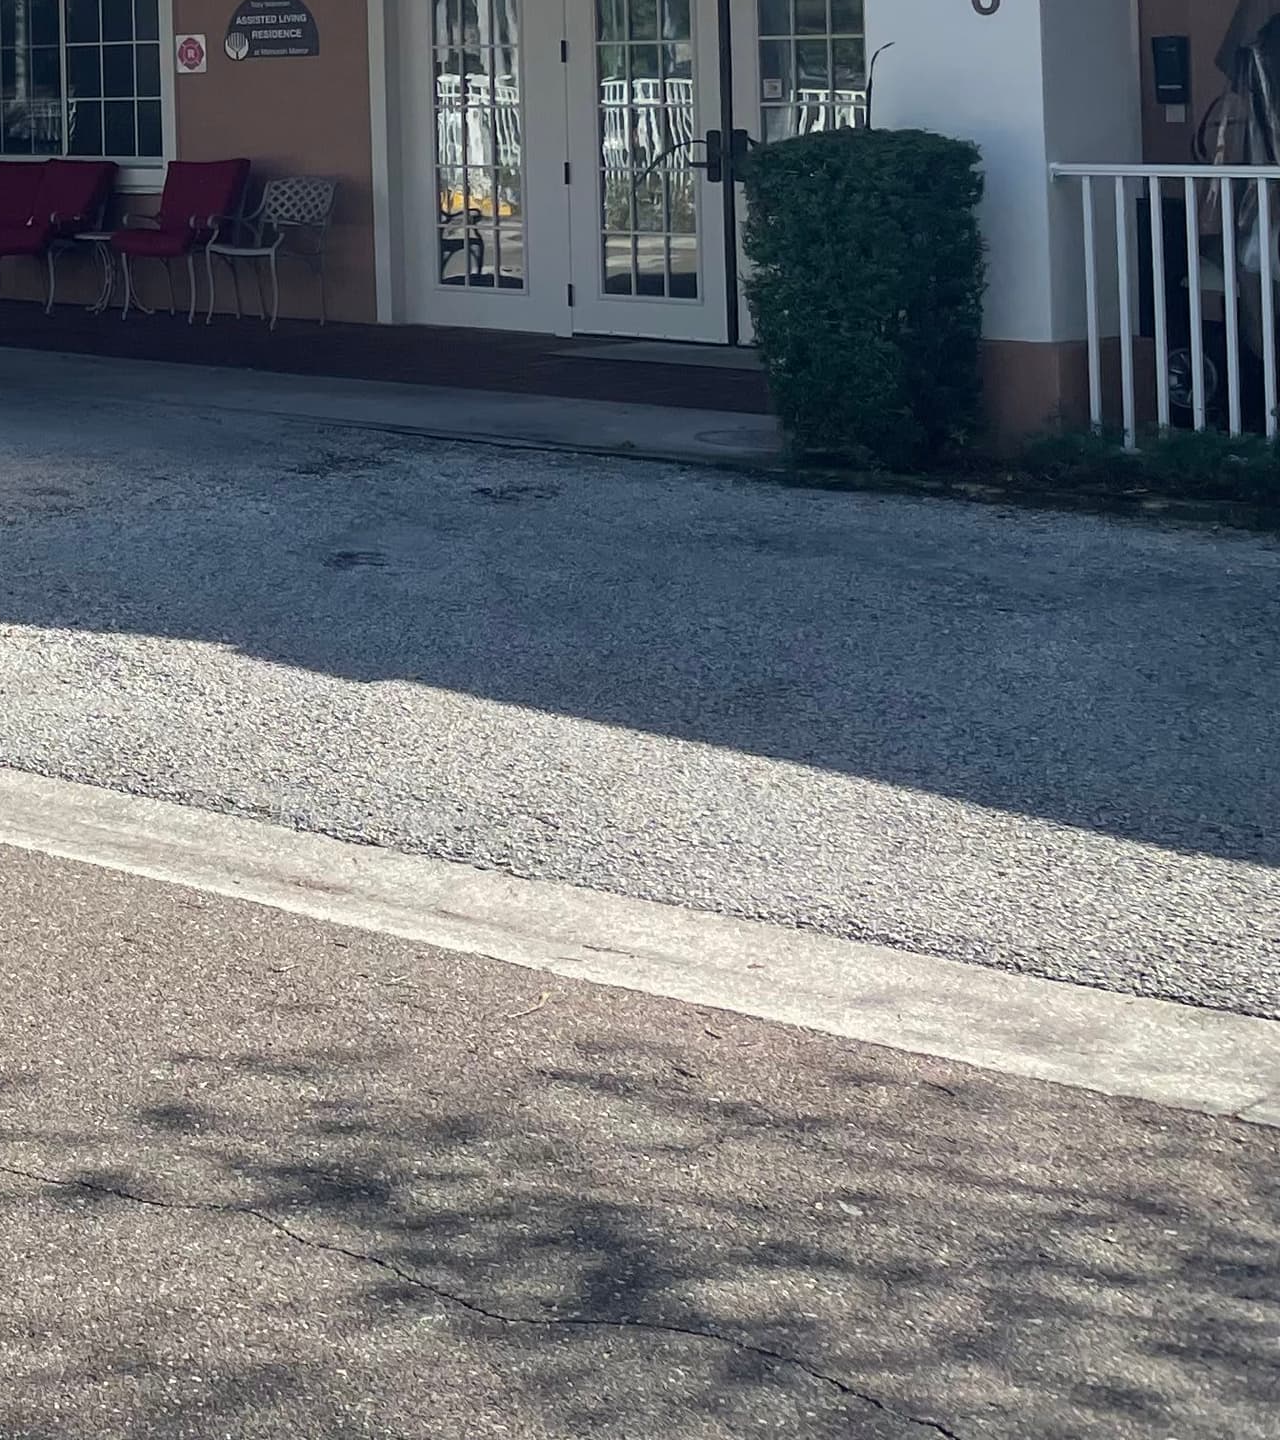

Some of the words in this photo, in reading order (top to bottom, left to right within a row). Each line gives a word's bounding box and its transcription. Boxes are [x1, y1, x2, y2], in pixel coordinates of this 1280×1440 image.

[236, 15, 277, 25] ASSISTED
[279, 13, 307, 24] LIVING
[251, 28, 302, 39] RESIDENCE
